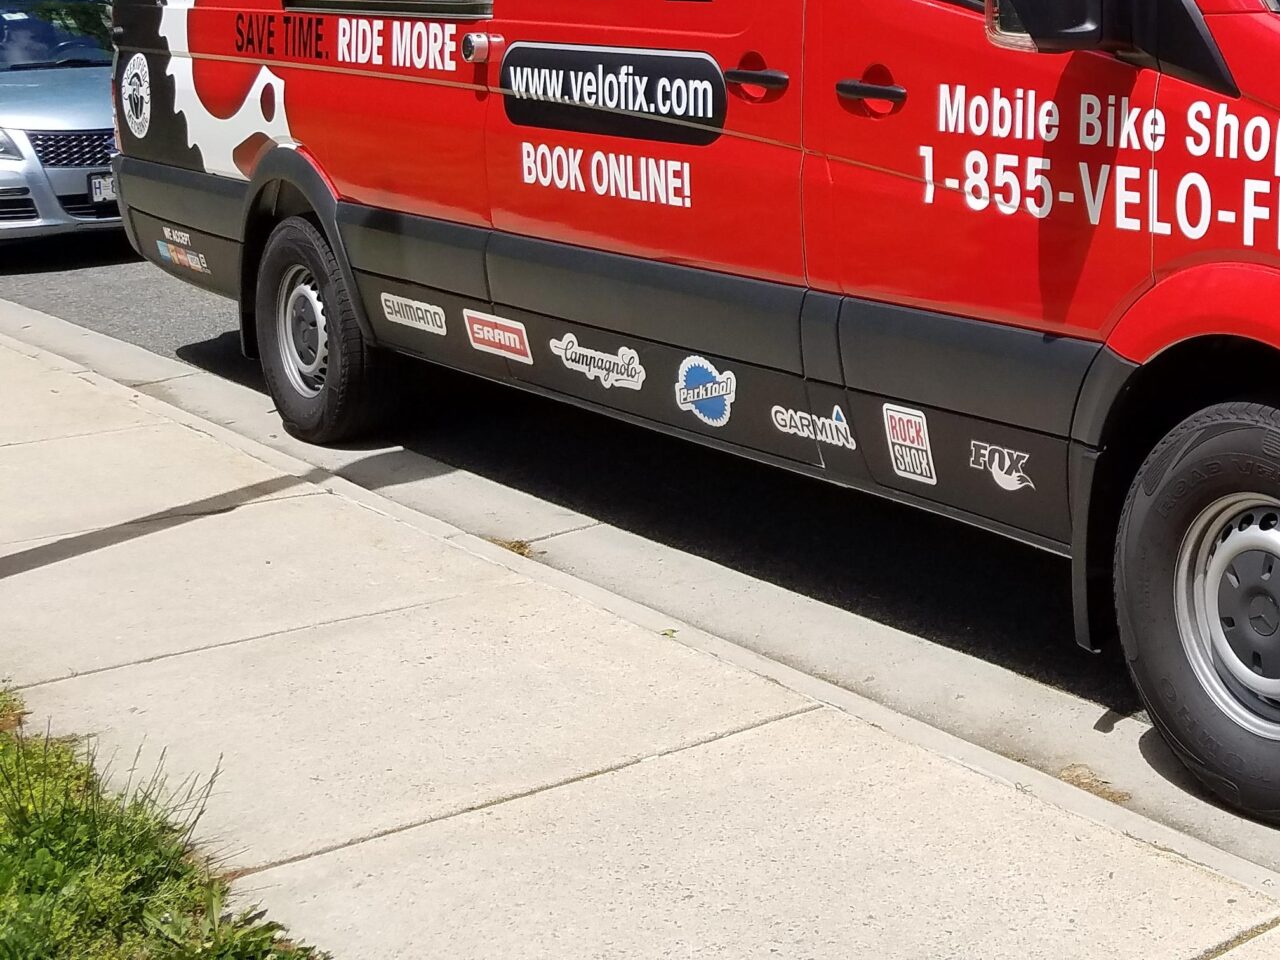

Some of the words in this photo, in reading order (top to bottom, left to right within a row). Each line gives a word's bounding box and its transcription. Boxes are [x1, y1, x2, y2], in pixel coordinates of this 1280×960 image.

[235, 13, 276, 55] SAVE
[282, 17, 329, 60] TIME.
[337, 18, 383, 66] RIDE
[391, 20, 457, 71] MORE
[508, 64, 713, 118] www.velofix.com
[938, 83, 1060, 142] Mobile
[1078, 93, 1167, 151] Bike
[521, 142, 586, 192] BOOK
[590, 151, 692, 208] ONLINE!
[383, 298, 444, 330] SHIMANO
[472, 324, 522, 349] SRAM
[553, 340, 642, 382] Campagnolo
[773, 409, 851, 446] GARMIN
[889, 414, 923, 444] ROCK
[895, 447, 930, 478] SHOX
[970, 441, 1030, 476] FOX
